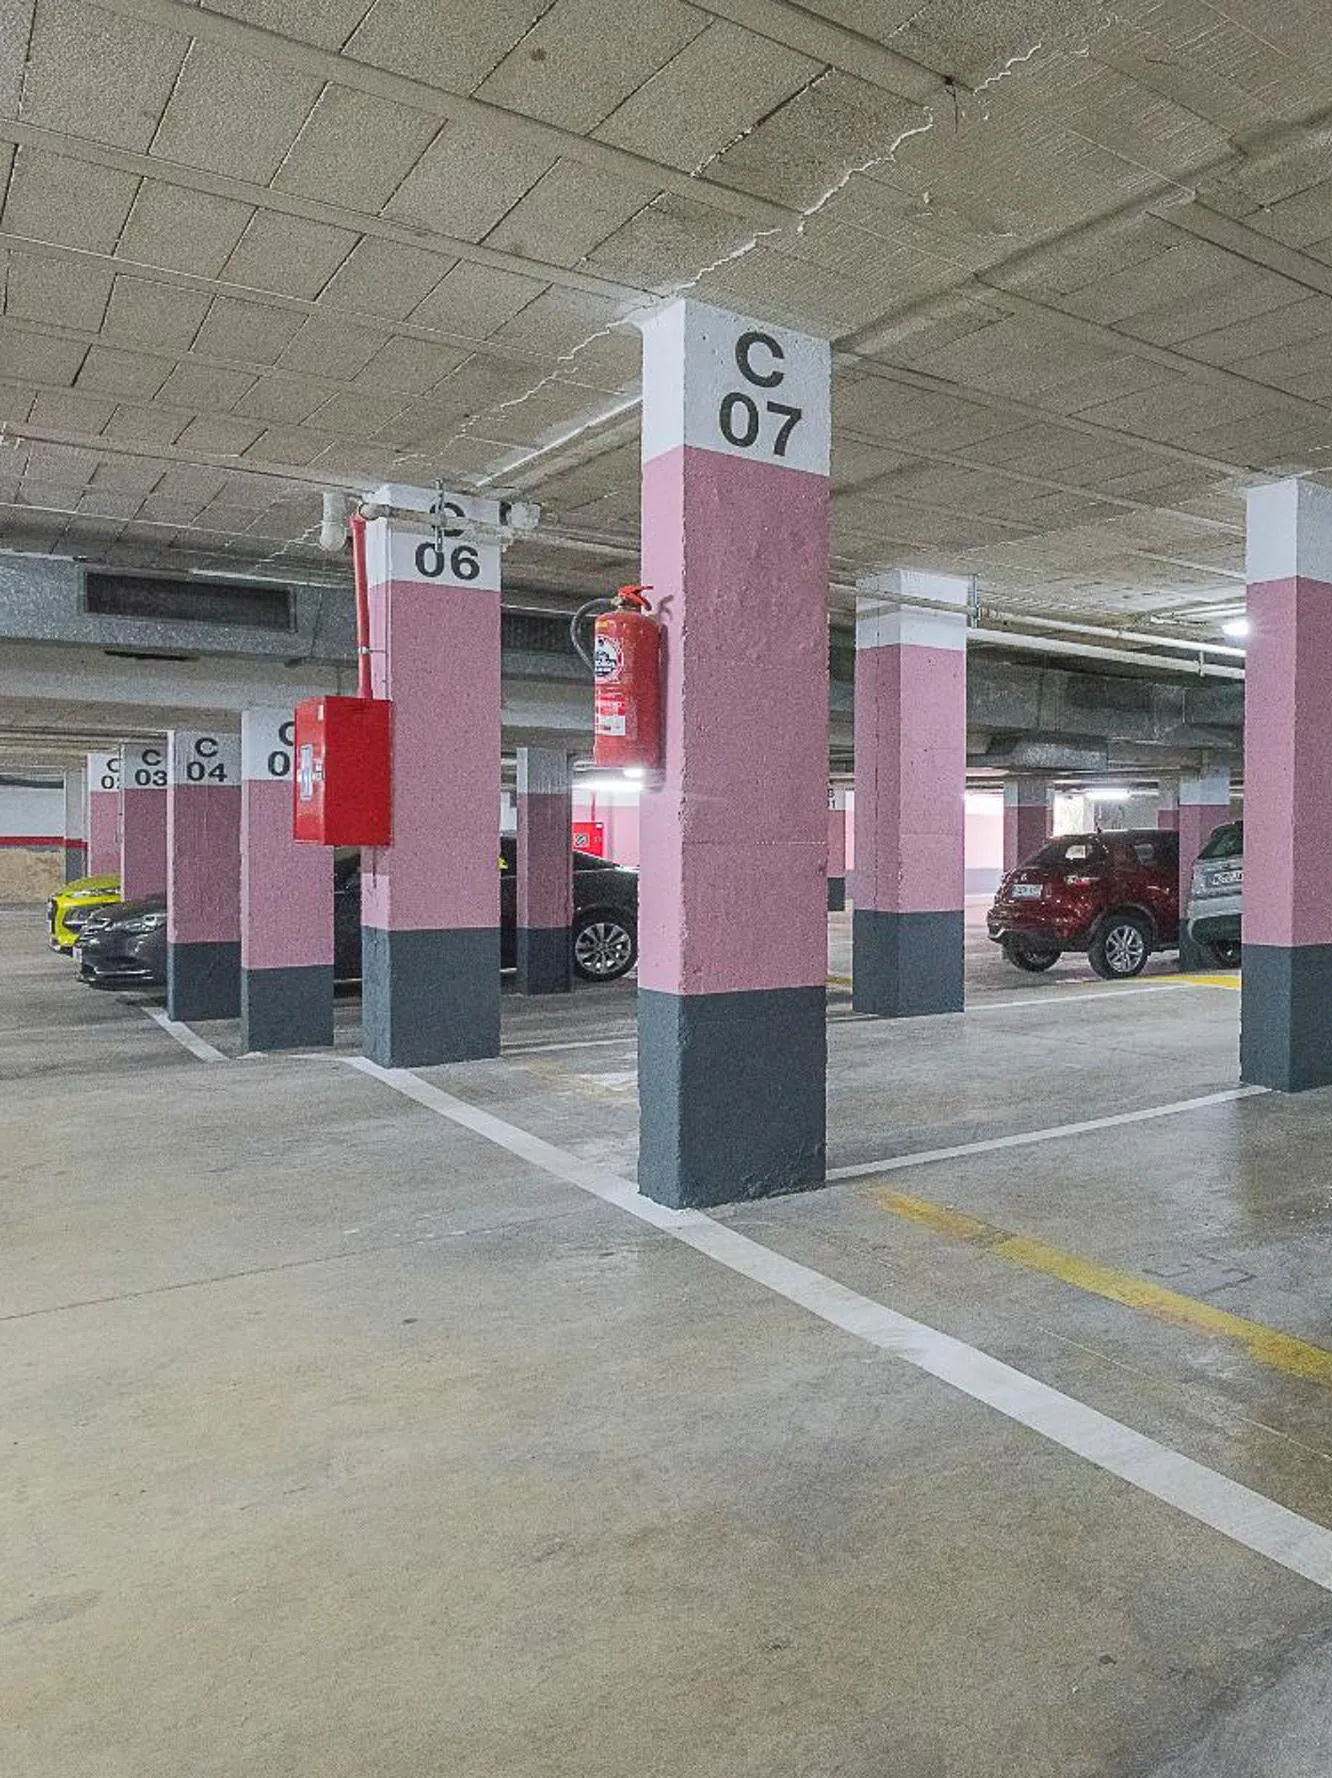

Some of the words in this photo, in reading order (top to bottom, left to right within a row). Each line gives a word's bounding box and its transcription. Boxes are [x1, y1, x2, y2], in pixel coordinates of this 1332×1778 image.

[735, 331, 784, 388] C
[719, 391, 802, 457] 07
[415, 541, 480, 581] 06
[142, 749, 162, 766] C
[194, 737, 219, 757] C
[186, 761, 228, 782] 04
[267, 750, 291, 777] 0
[101, 775, 120, 789] 0
[134, 769, 168, 787] 03
